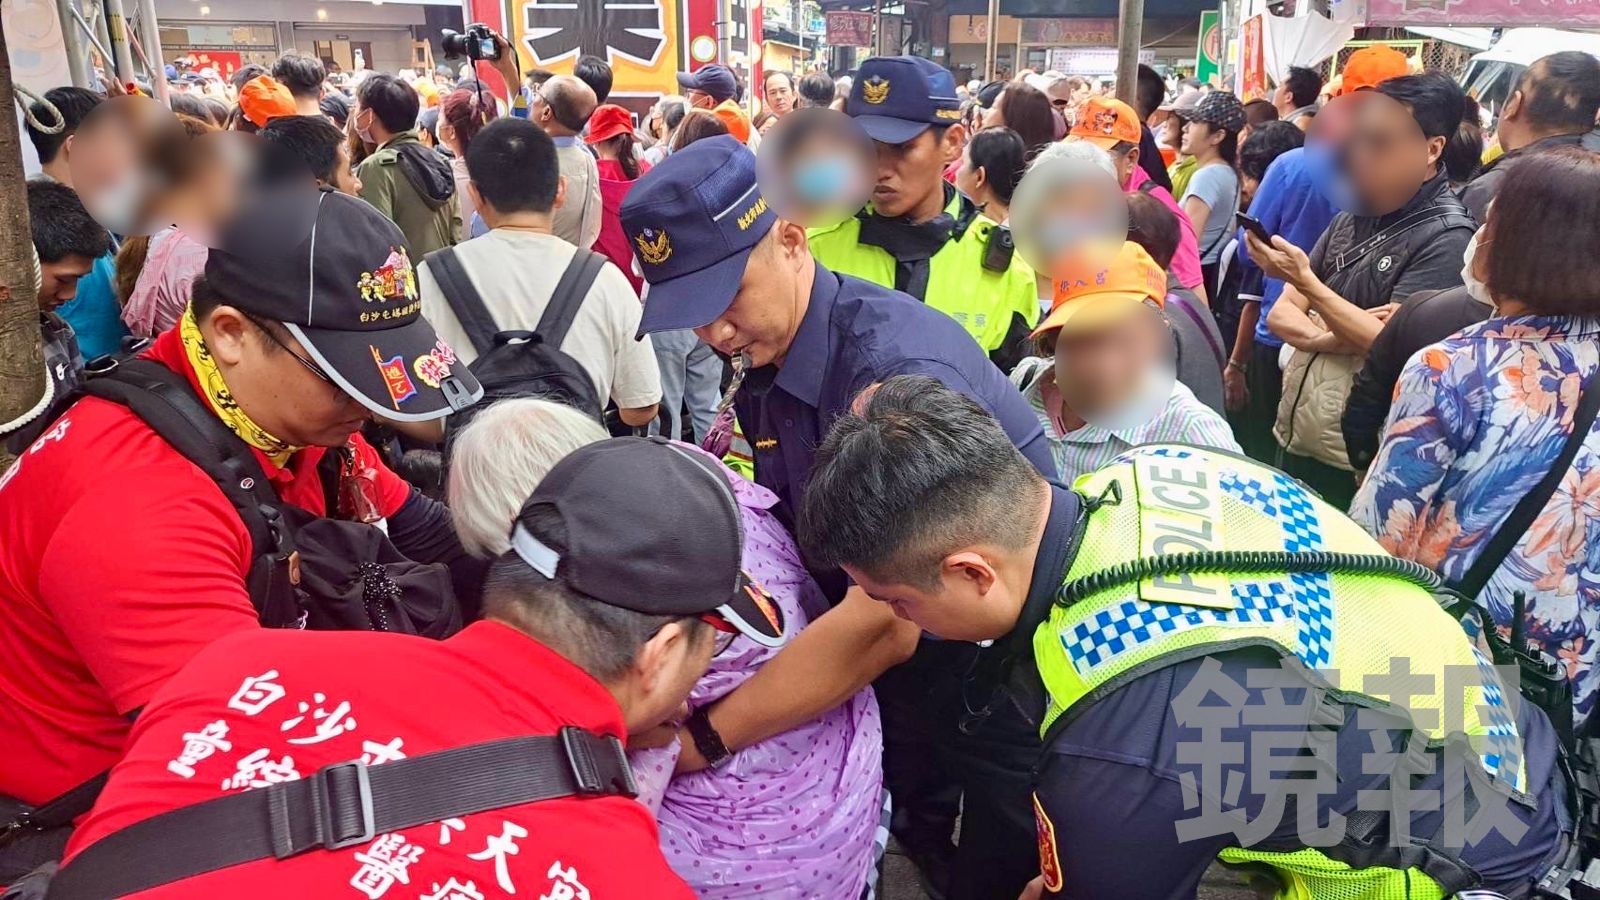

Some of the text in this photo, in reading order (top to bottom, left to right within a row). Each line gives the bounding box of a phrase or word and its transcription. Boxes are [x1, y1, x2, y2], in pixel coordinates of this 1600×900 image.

[1149, 465, 1217, 595] POLICE
[228, 669, 592, 900] 白沙天宮
